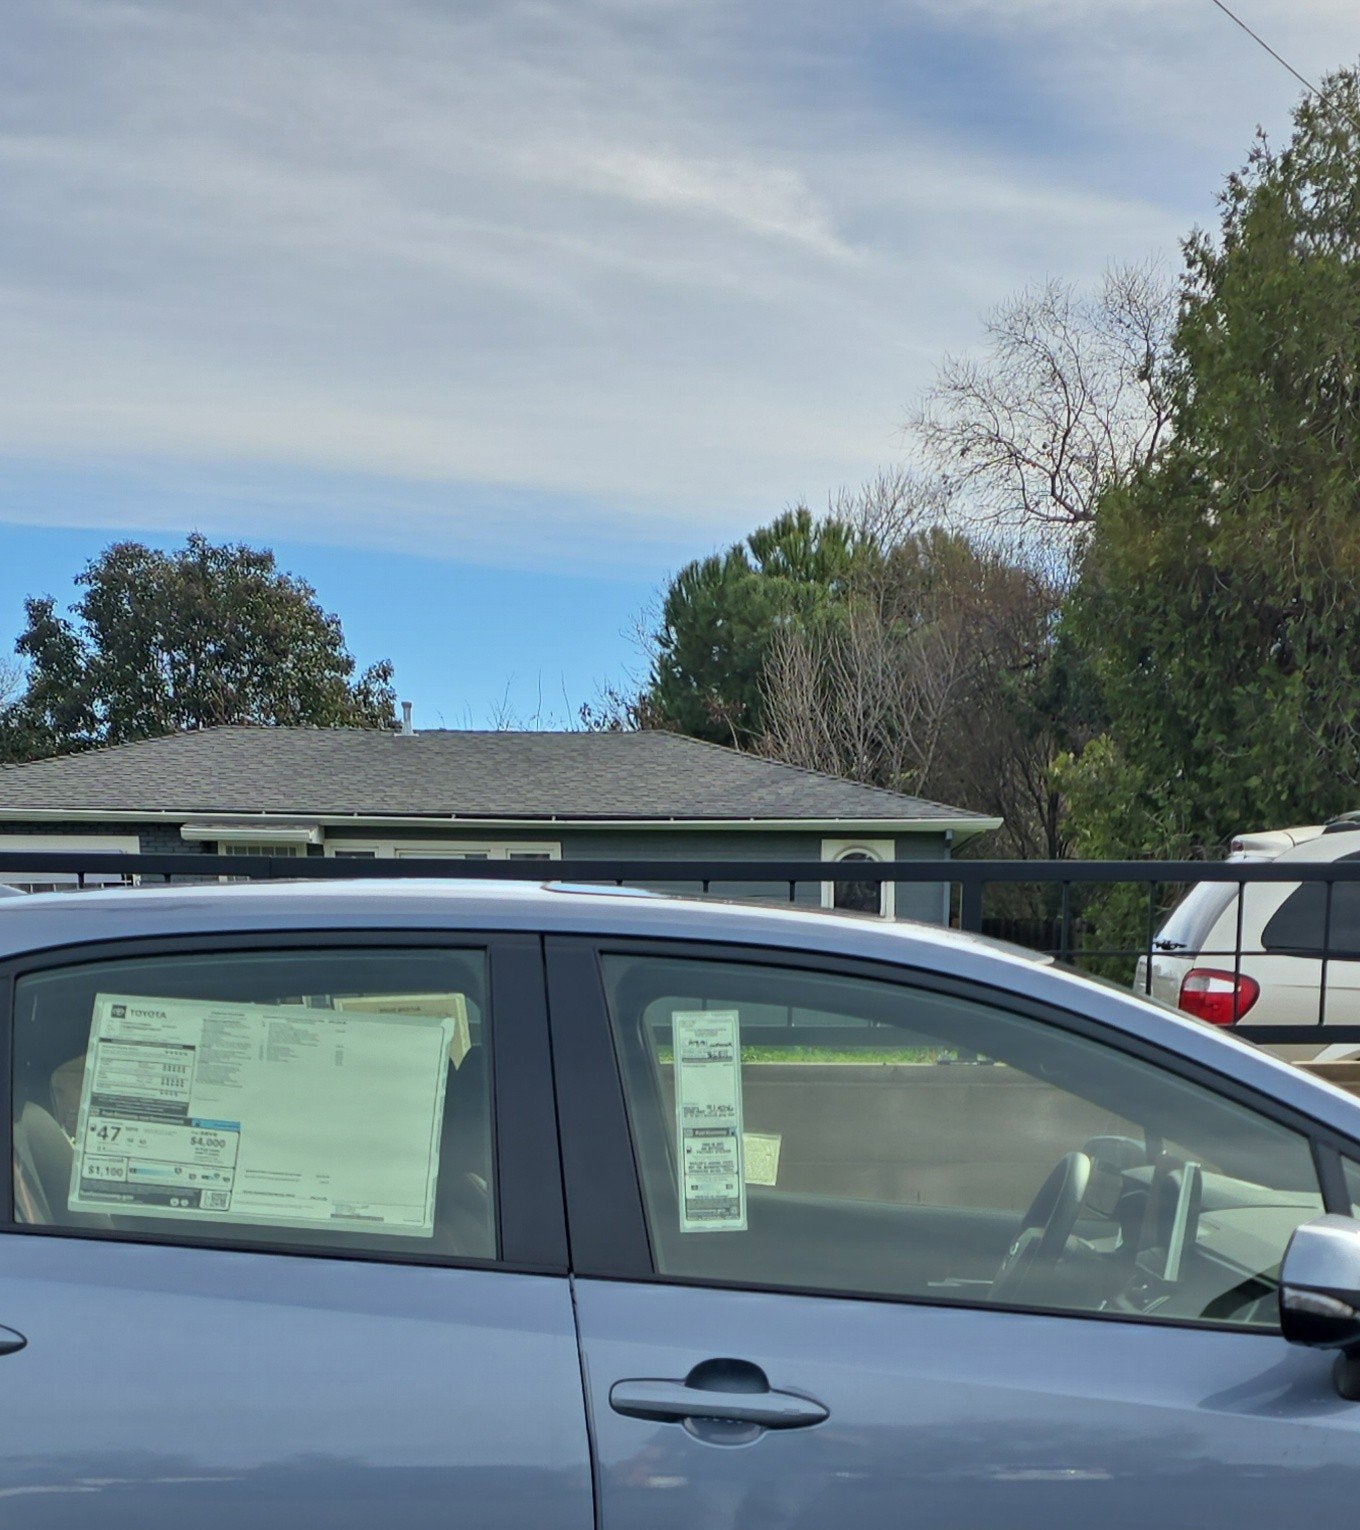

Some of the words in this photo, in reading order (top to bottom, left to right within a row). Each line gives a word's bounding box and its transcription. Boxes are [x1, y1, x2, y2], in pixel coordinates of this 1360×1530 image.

[130, 1009, 167, 1019] TOYOTA
[96, 1124, 122, 1142] 47
[190, 1136, 227, 1149] $4,000
[88, 1165, 124, 1178] $1,100
